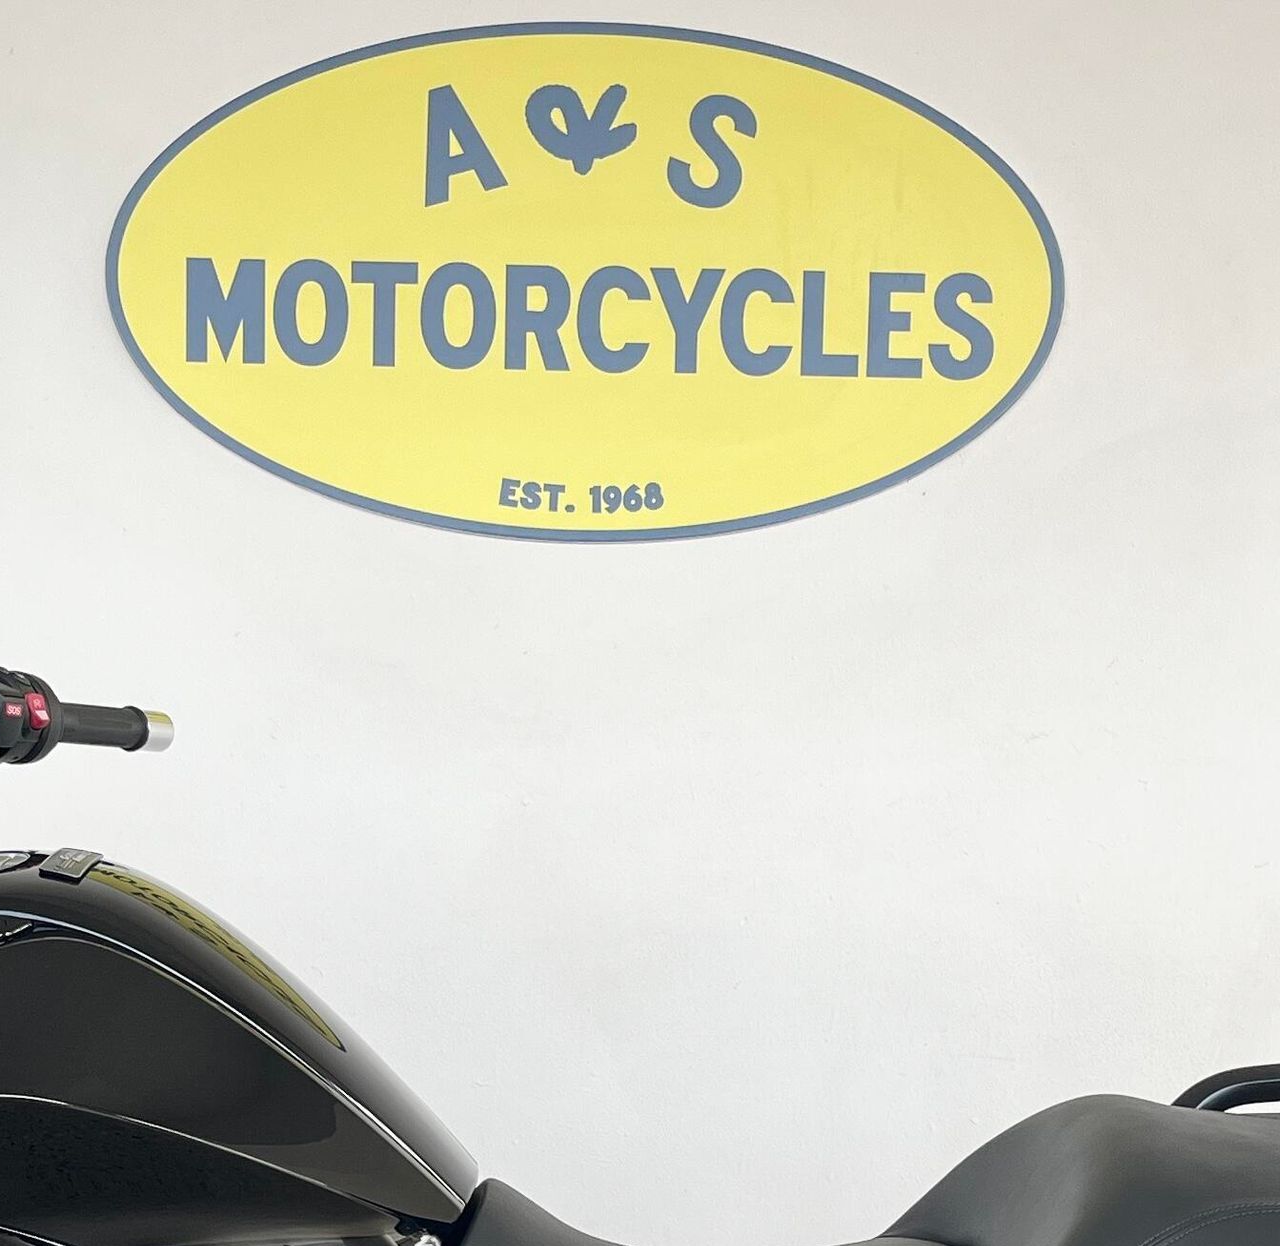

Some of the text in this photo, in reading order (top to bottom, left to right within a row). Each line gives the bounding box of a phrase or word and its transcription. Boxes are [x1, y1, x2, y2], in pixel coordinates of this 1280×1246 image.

[424, 84, 508, 207] A
[666, 94, 757, 209] S
[184, 256, 994, 381] MOTORCYCLES
[498, 477, 664, 514] EST. 1968
[6, 704, 22, 716] SOS
